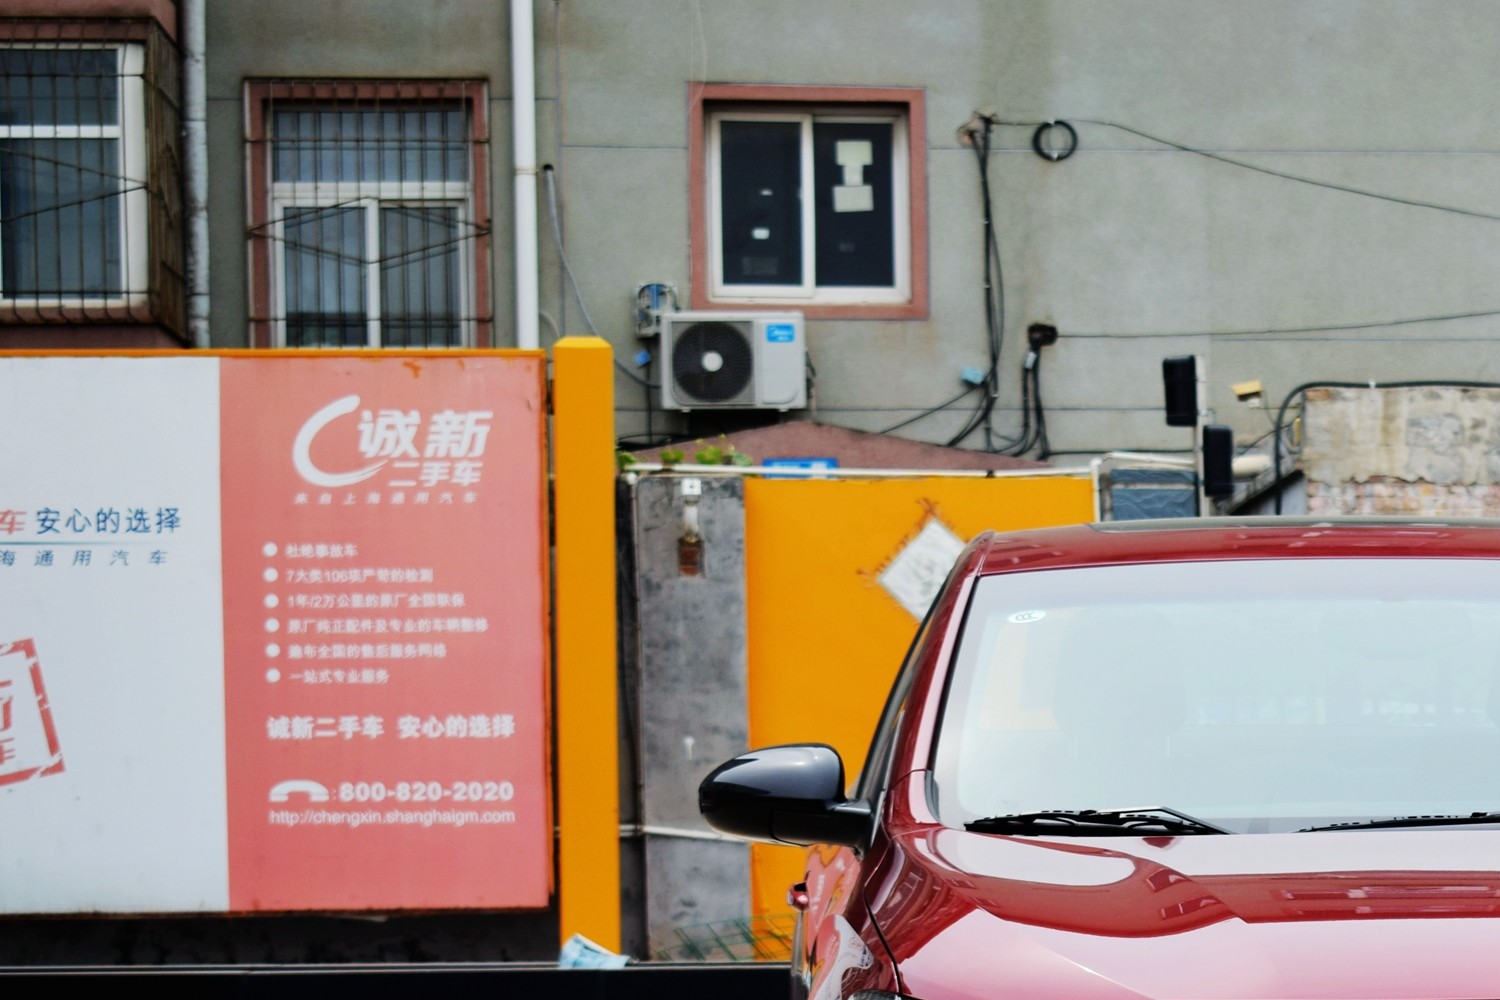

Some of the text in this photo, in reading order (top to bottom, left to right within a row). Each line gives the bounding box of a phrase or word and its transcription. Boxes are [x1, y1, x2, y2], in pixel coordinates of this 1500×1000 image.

[358, 409, 494, 458] 诚新
[388, 461, 484, 487] 二手车
[293, 492, 479, 505] 来自上海通用汽车
[36, 507, 181, 534] 安心的选择
[267, 714, 516, 740] 诚新二手车 安心的选择
[339, 781, 515, 802] 800-820-2020
[269, 810, 516, 828] http://chengxin.shanghaigm.com
